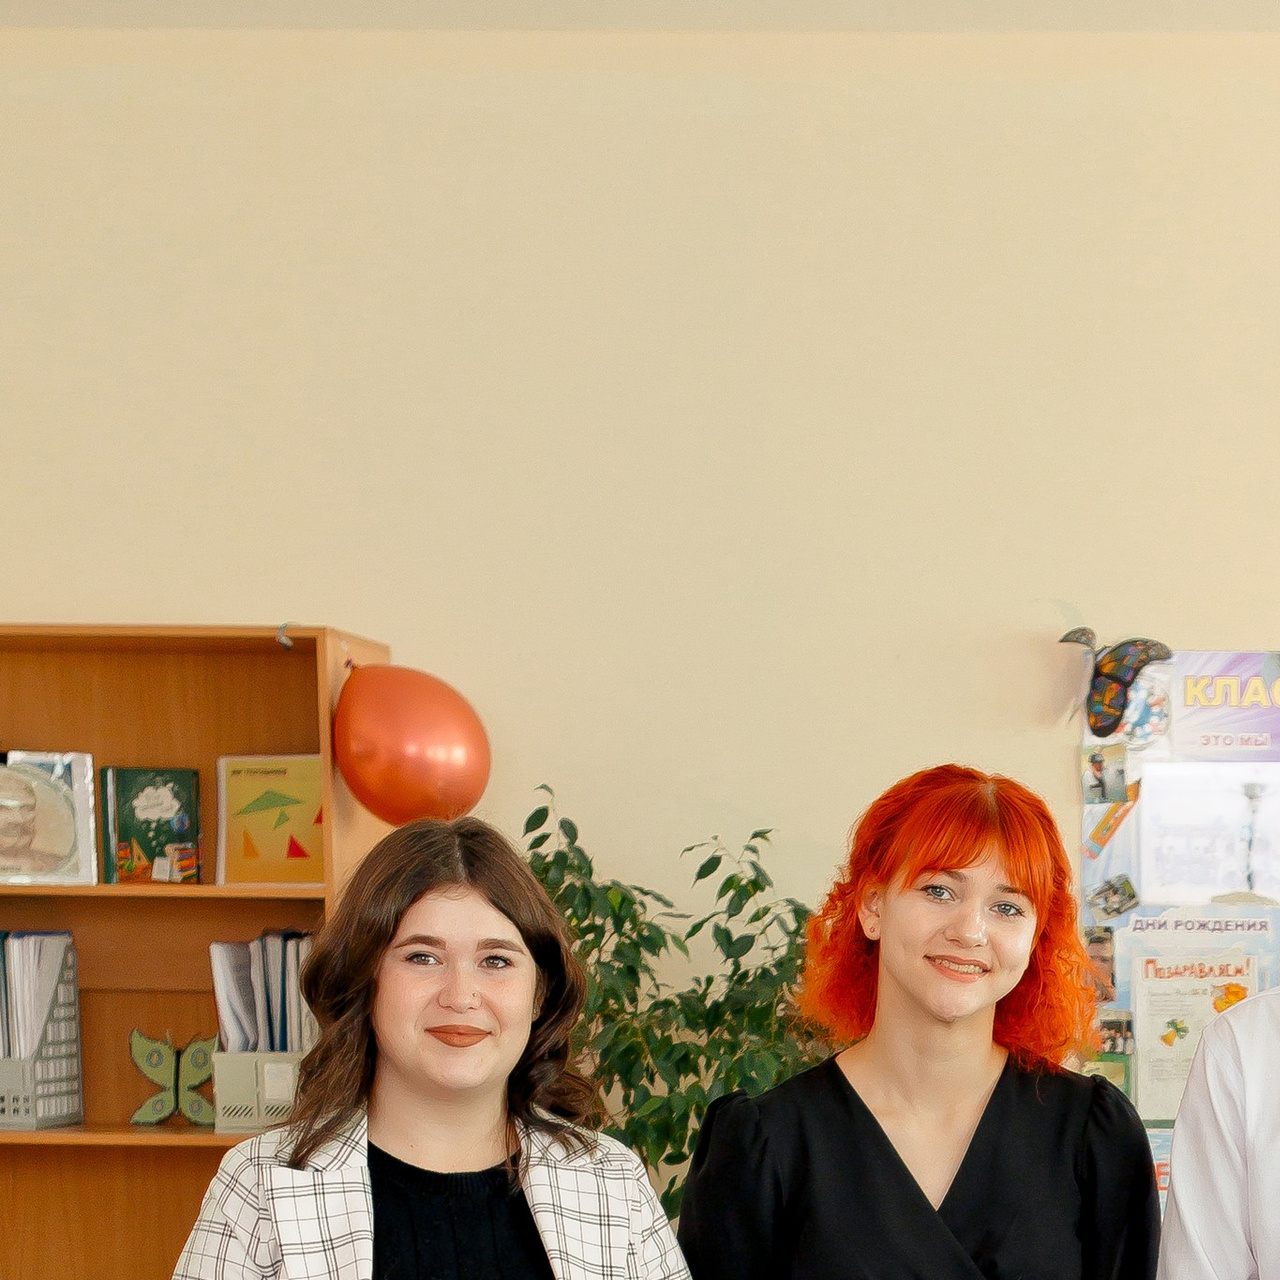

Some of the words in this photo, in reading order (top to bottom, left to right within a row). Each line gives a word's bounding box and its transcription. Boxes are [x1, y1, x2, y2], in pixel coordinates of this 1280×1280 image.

[1201, 734, 1234, 746] ЭТО
[1132, 919, 1169, 932] ДНИ
[1174, 919, 1268, 933] РОЖДЕНИЯ
